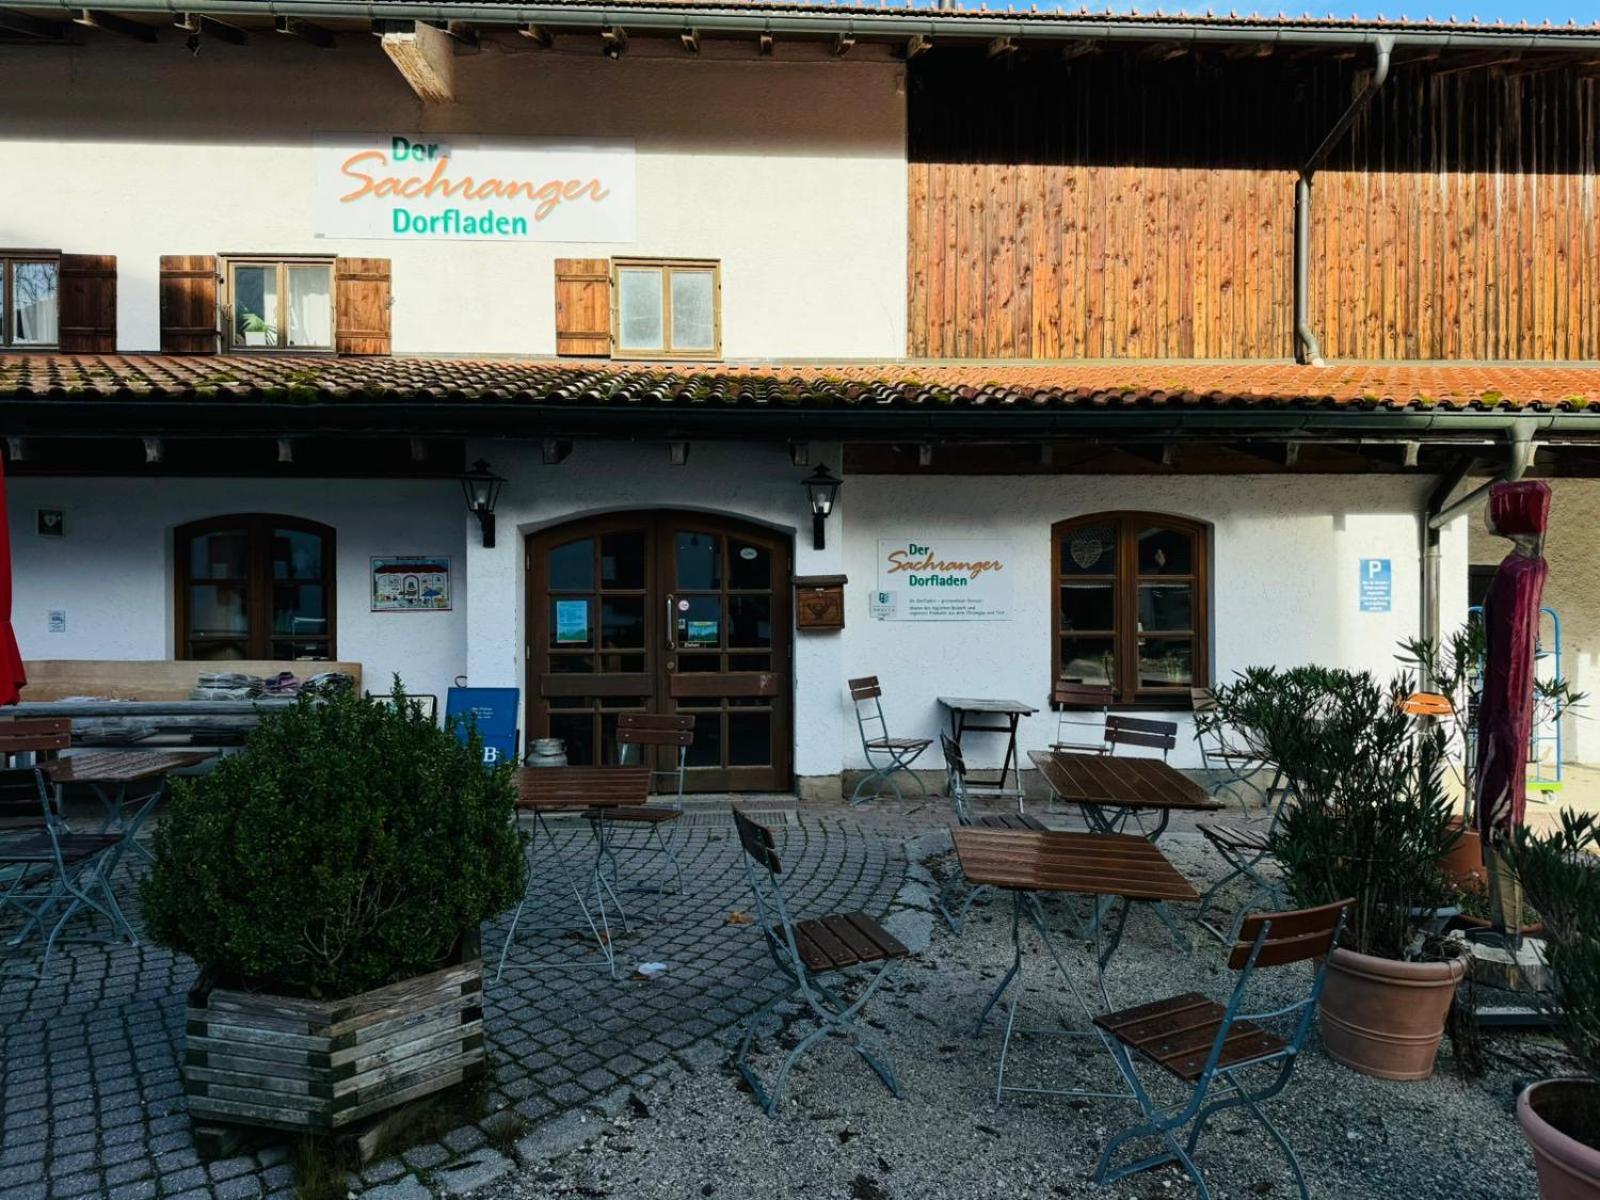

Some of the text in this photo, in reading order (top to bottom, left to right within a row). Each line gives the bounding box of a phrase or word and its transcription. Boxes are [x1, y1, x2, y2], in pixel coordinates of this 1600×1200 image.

[391, 136, 438, 161] Der
[339, 150, 610, 222] Sachranger
[392, 208, 528, 235] Dorfladen
[909, 543, 930, 555] Der
[887, 550, 1003, 580] Sachranger
[1369, 561, 1381, 578] P
[909, 574, 968, 587] Dorfladen
